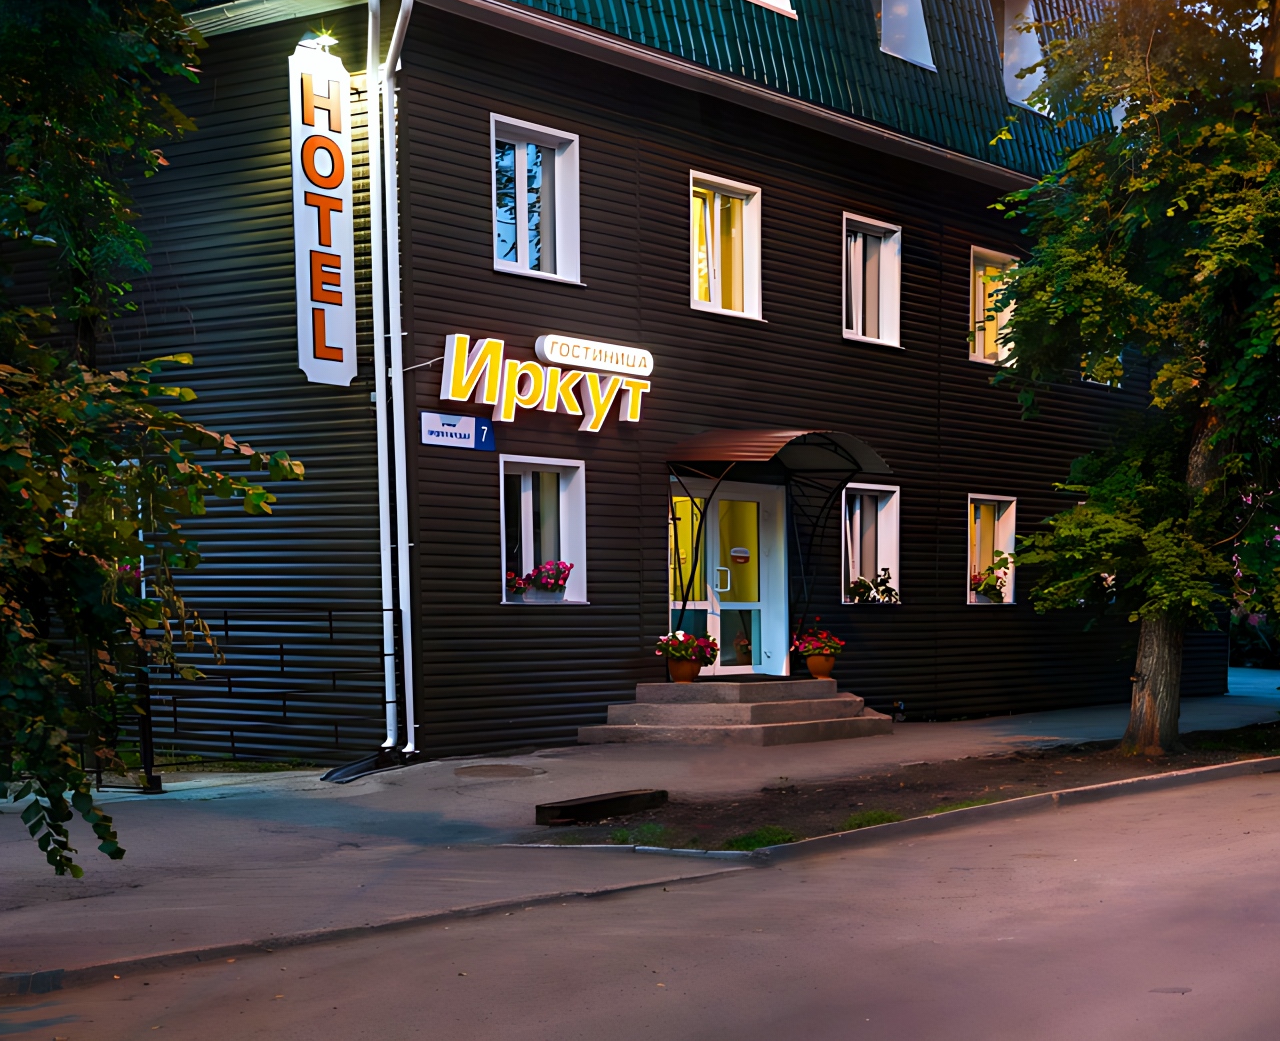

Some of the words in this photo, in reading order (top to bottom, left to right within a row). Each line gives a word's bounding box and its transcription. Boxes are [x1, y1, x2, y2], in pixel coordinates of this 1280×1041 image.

[300, 72, 344, 362] HOTEL
[447, 334, 650, 432] Иркут
[550, 341, 648, 369] ГОСТИНИЦА
[481, 425, 489, 443] 7
